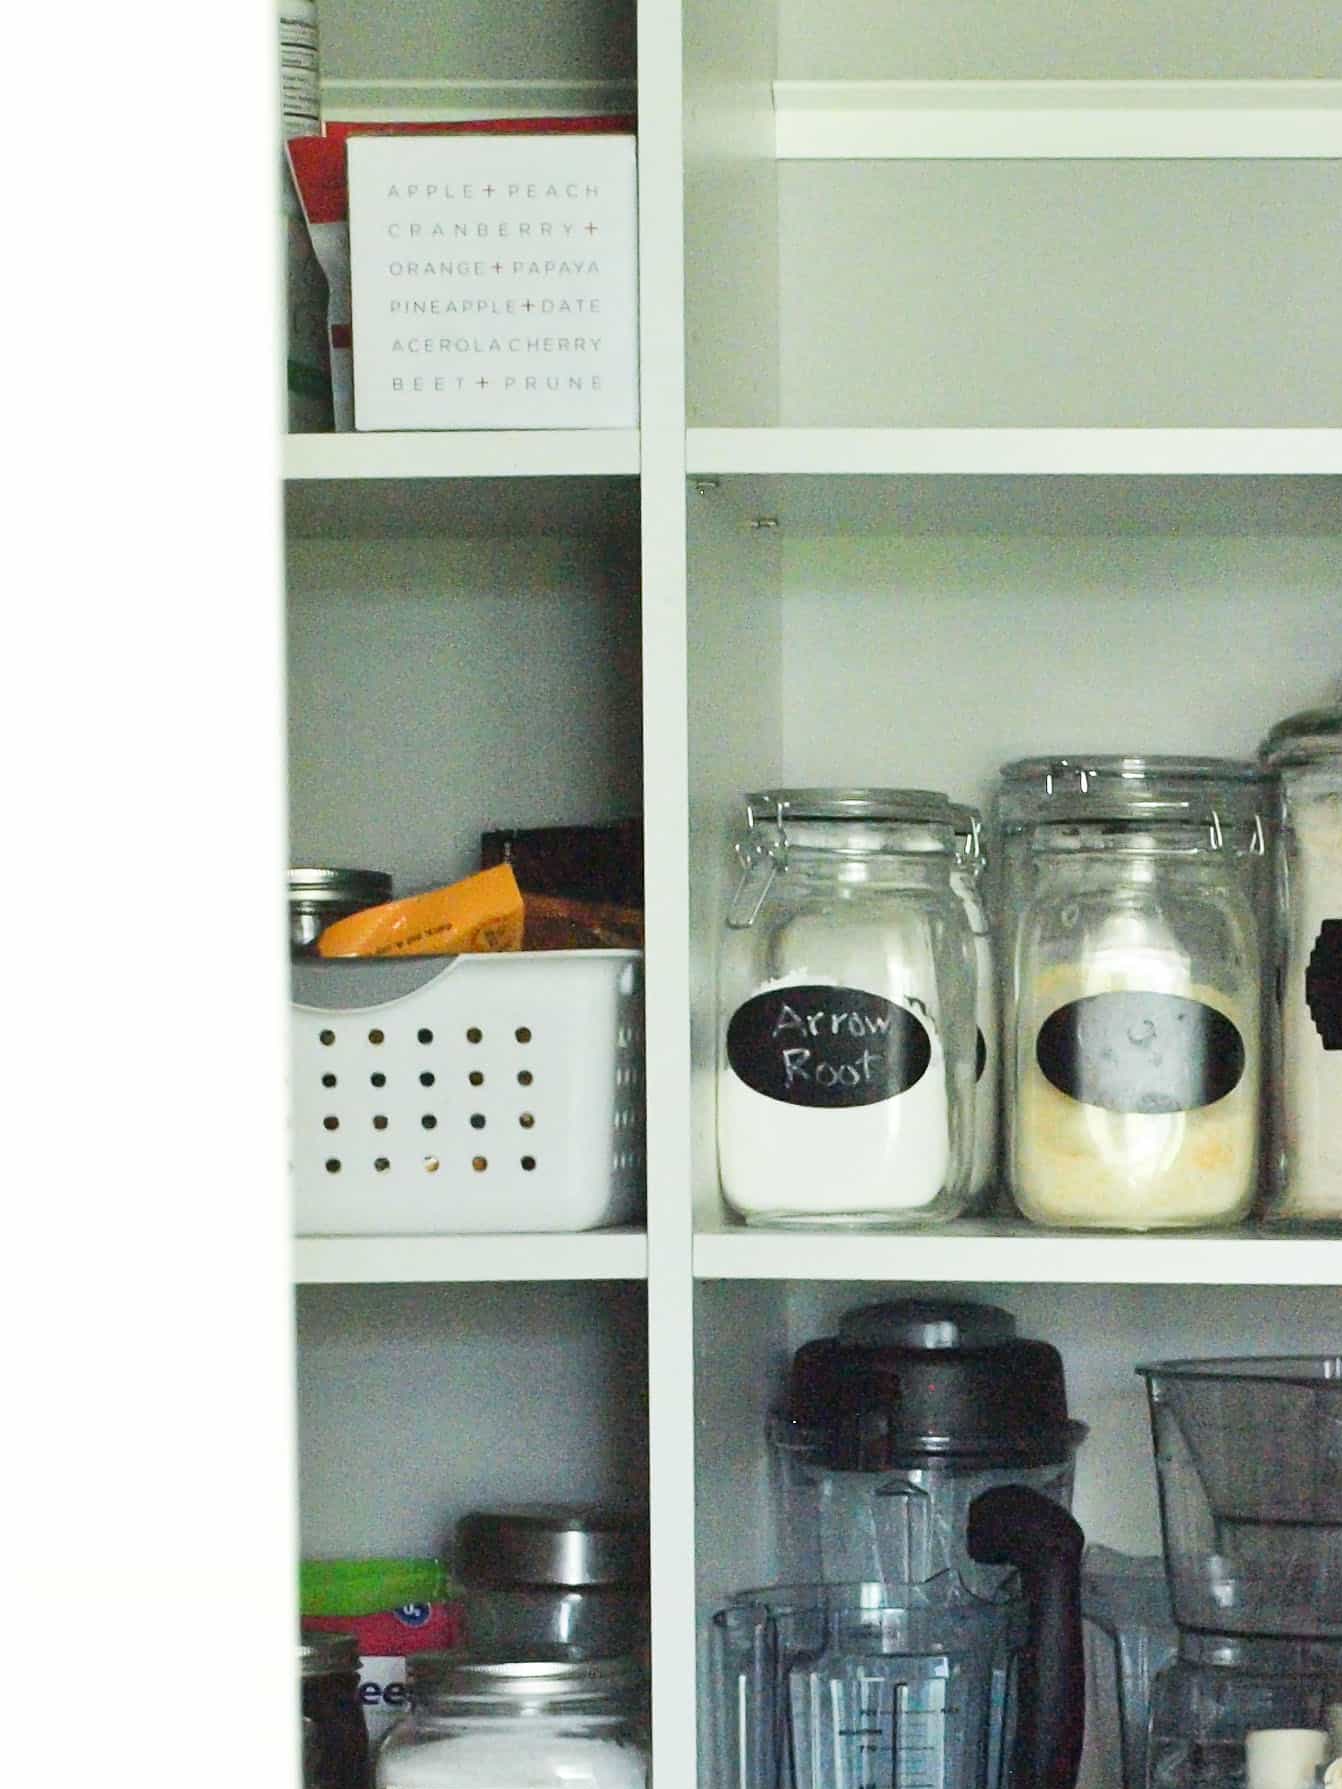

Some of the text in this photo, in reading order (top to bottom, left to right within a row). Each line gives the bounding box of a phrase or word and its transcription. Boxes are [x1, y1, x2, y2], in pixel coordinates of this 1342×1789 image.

[392, 376, 464, 392] BEET
[504, 376, 603, 392] PRUNE
[771, 1001, 892, 1038] Arrow
[782, 1048, 885, 1089] Root
